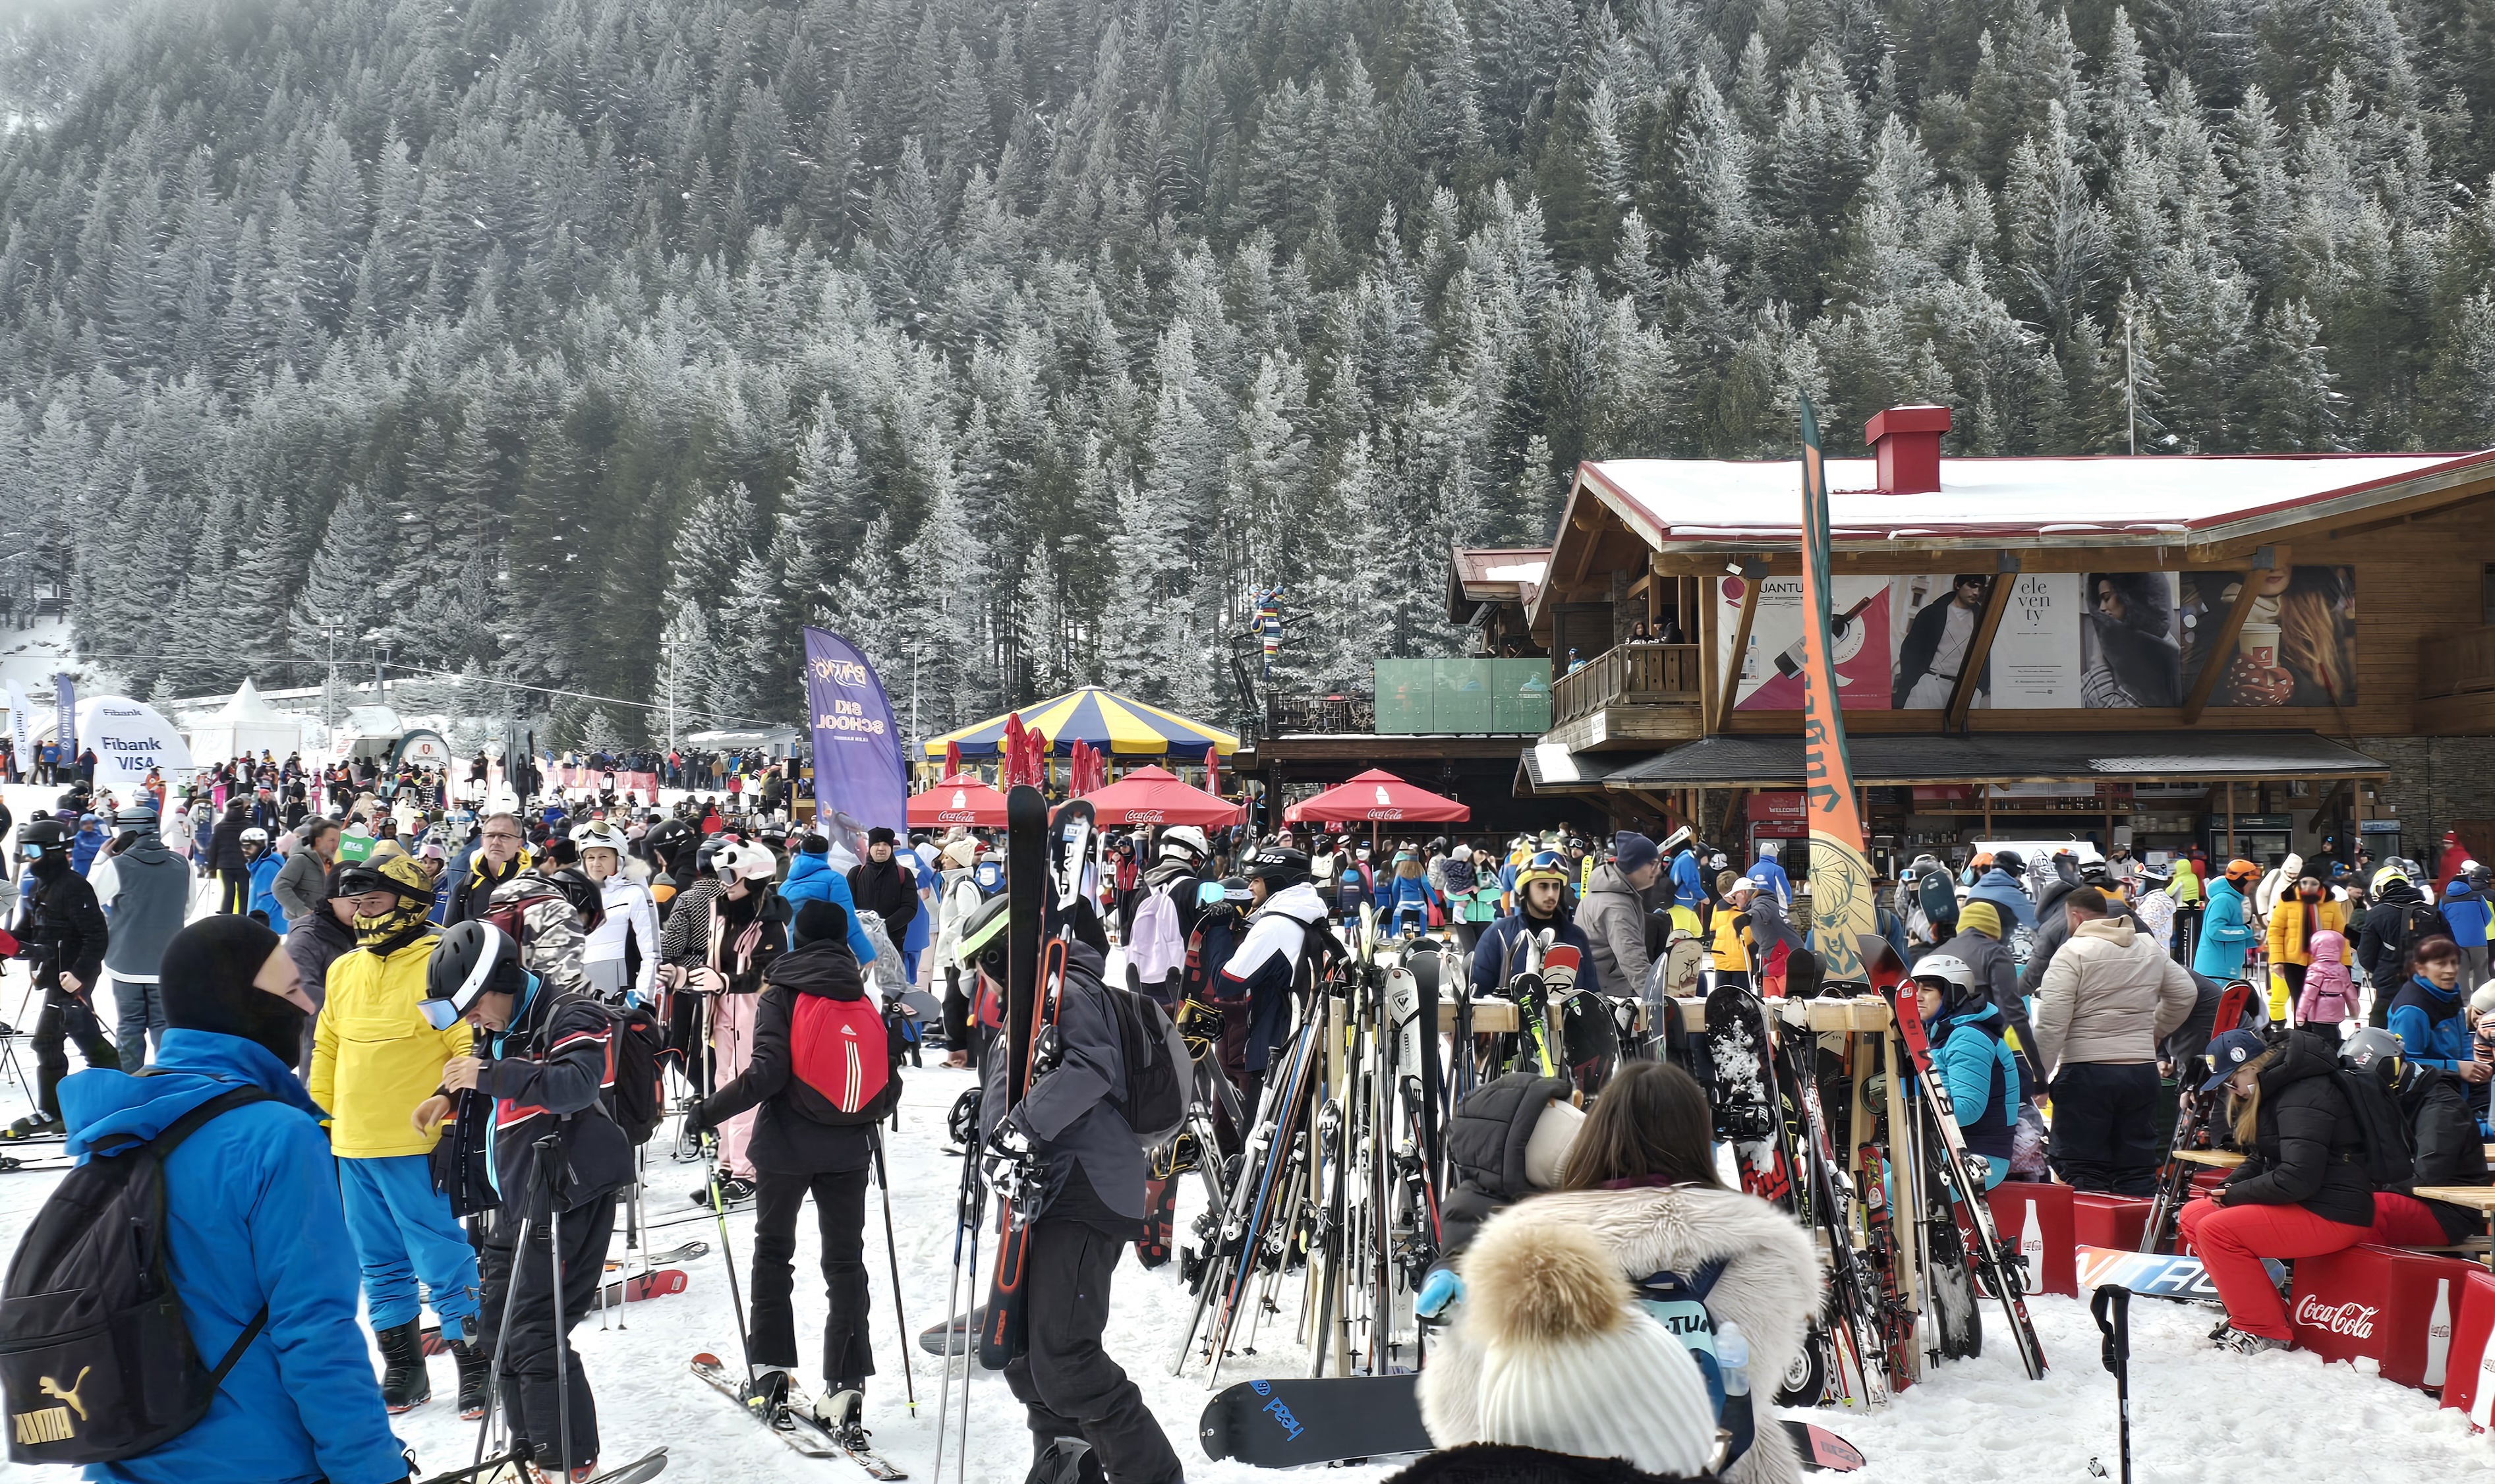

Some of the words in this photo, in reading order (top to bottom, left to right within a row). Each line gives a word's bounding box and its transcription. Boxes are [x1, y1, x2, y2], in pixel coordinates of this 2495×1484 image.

[1760, 583, 1804, 593] UANTU
[2021, 577, 2047, 594] ele
[2018, 596, 2050, 607] ven
[2026, 610, 2043, 626] ty
[101, 737, 163, 751] Fibank
[115, 756, 156, 770] VISA
[2295, 1294, 2380, 1340] Coca-Cola
[12, 1406, 74, 1445] PUMA
